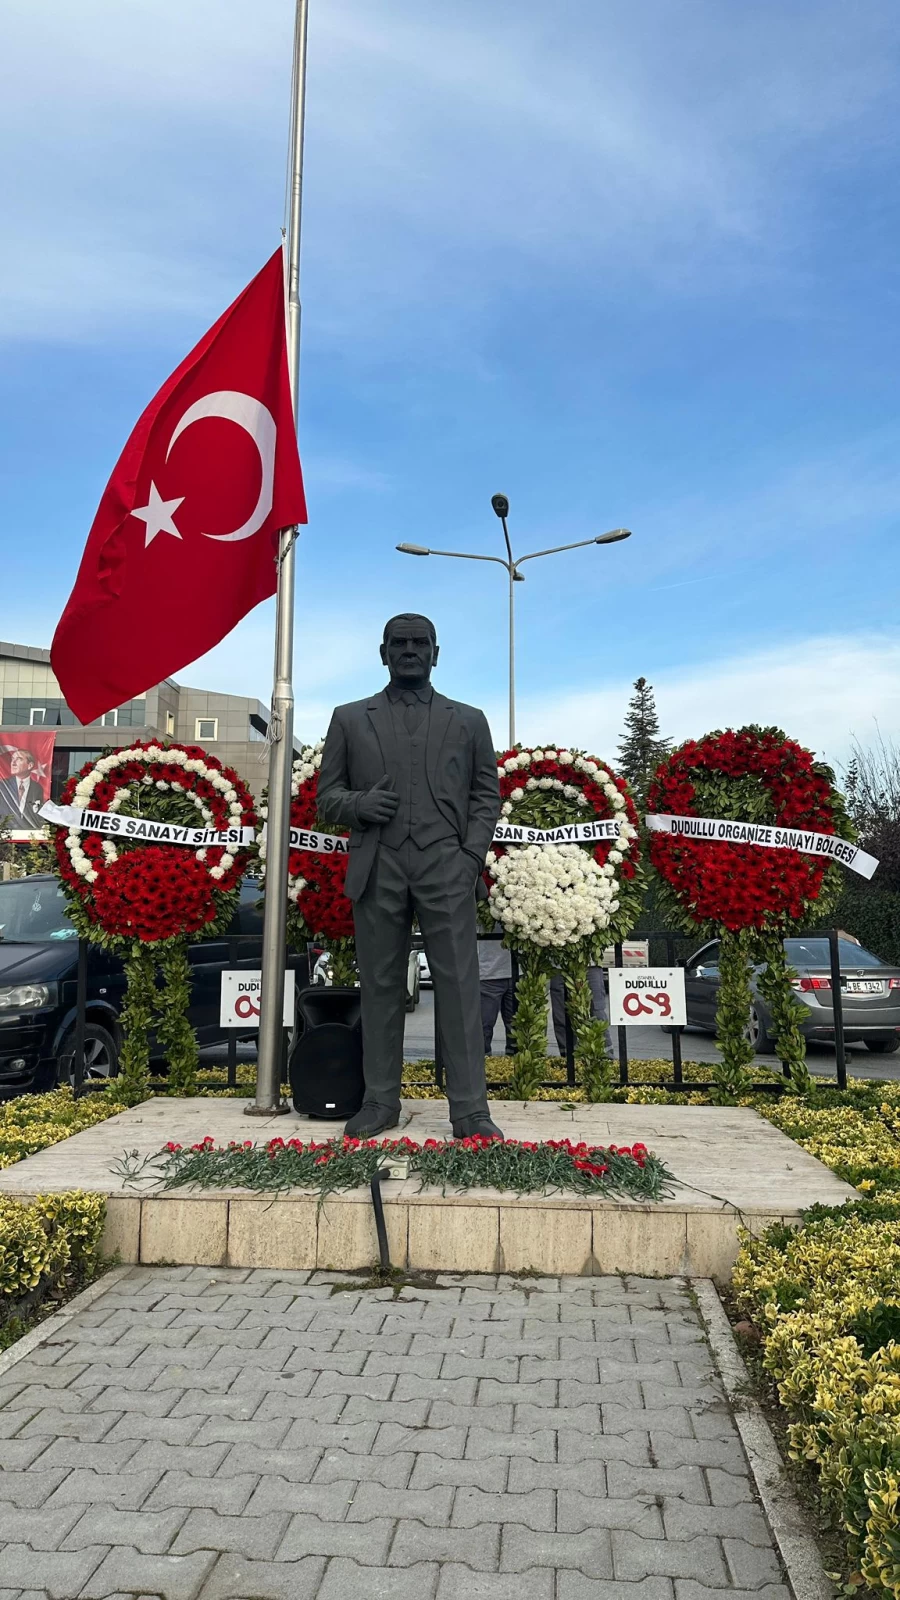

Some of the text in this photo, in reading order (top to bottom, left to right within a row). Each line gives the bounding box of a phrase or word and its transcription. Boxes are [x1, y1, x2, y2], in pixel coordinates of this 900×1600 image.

[80, 809, 244, 843] İMES SANAYİ SİTESİ
[494, 820, 624, 842] SAN SANAYİ SİTES
[323, 837, 350, 852] SA
[671, 819, 860, 865] DUDULLU ORGANİZE SANAYİ BÖLGESİ
[625, 980, 667, 989] DUDULLU
